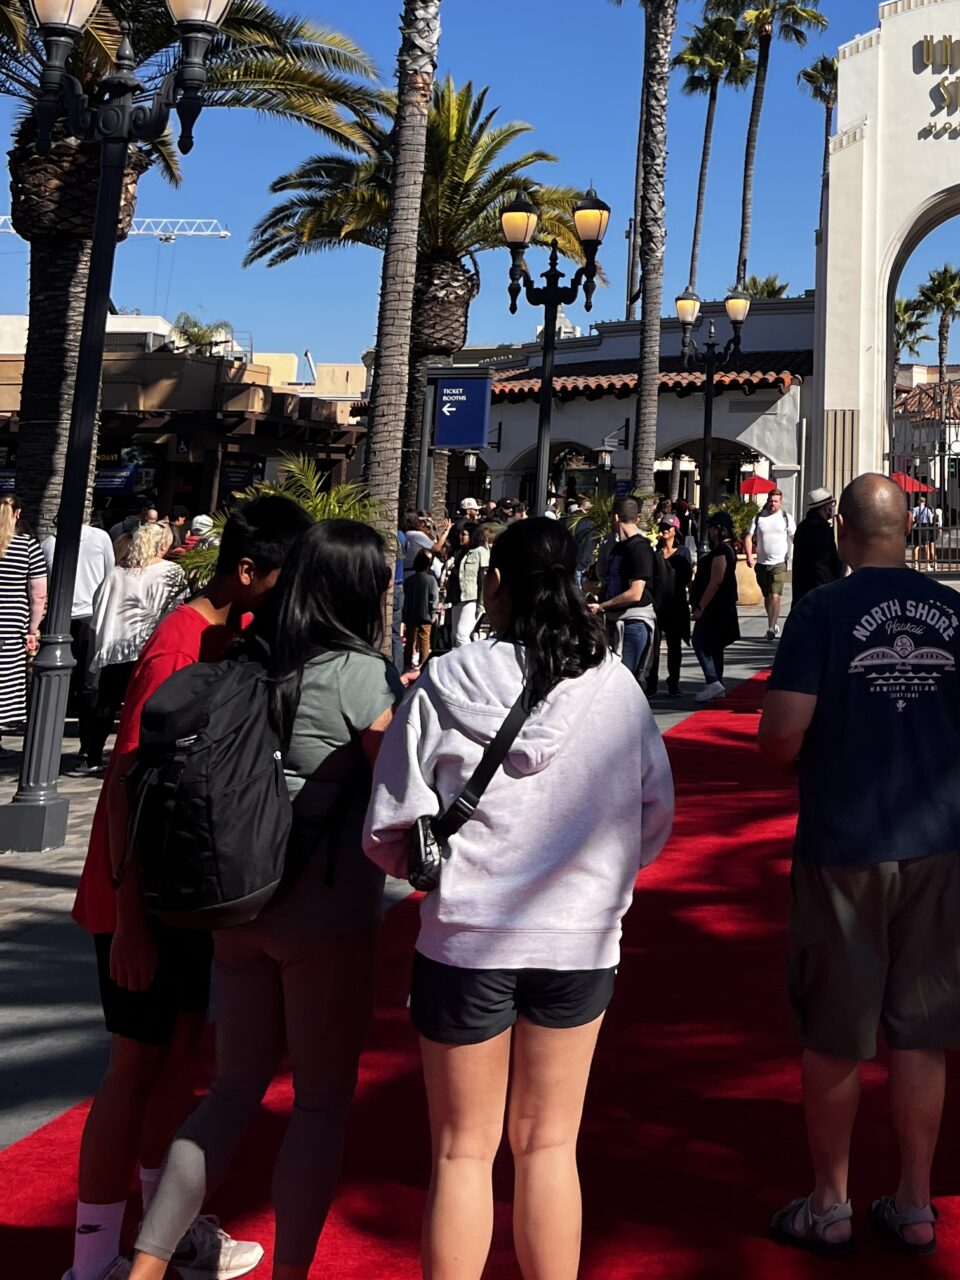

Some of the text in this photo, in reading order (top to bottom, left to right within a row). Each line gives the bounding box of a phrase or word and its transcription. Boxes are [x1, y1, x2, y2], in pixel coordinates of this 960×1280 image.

[105, 496, 112, 508] 7
[852, 599, 956, 642] NORTH SHORE
[886, 618, 925, 635] Hawaii
